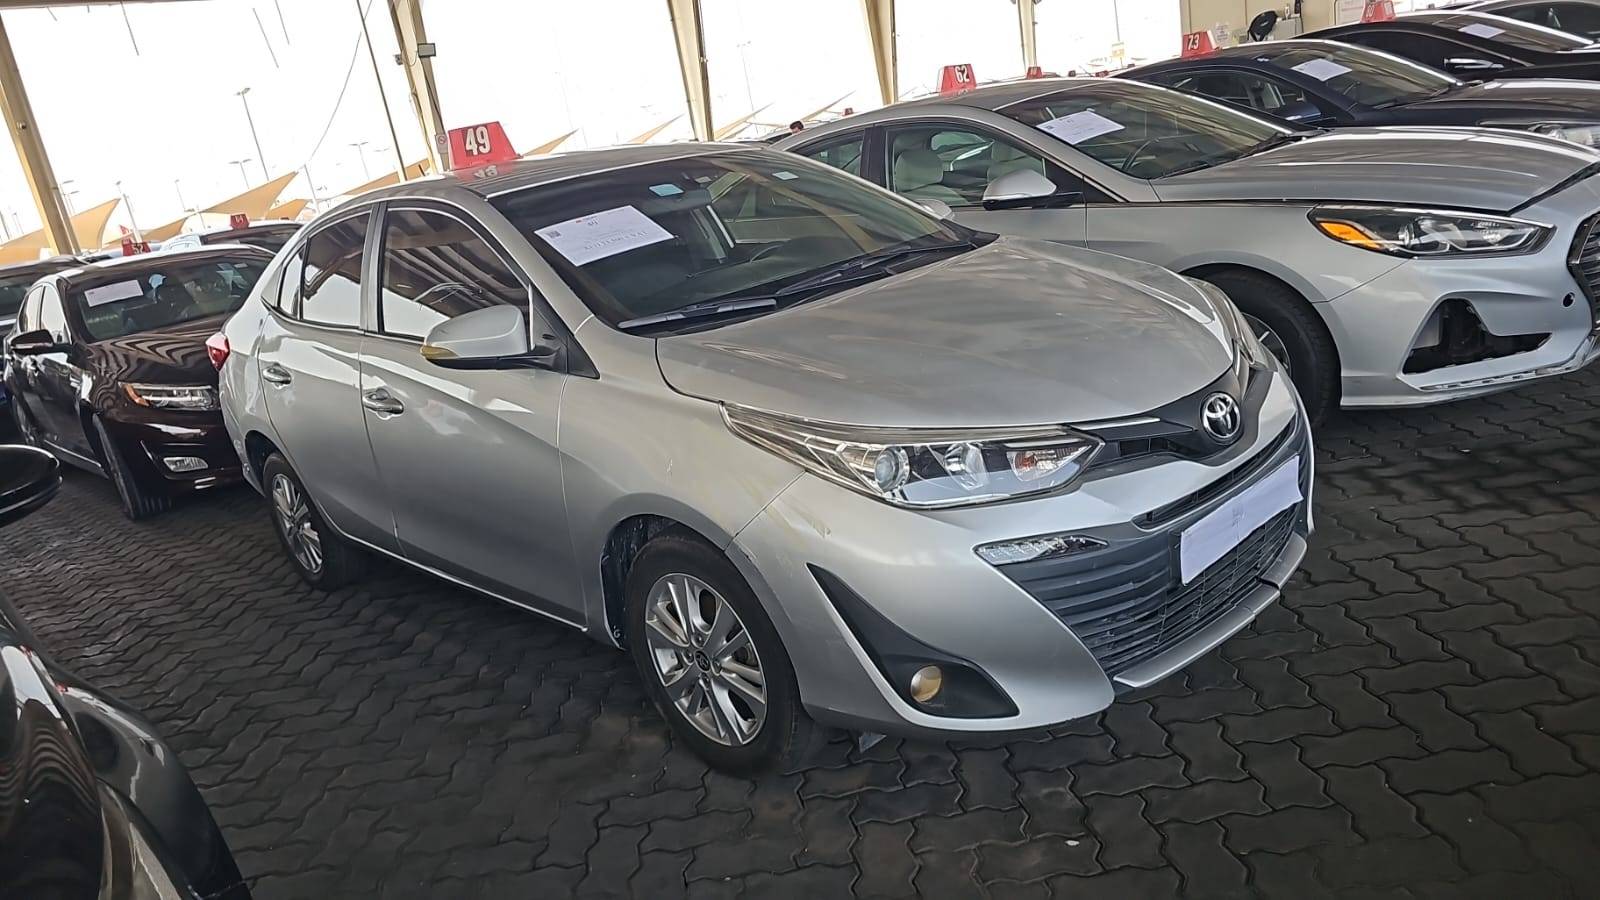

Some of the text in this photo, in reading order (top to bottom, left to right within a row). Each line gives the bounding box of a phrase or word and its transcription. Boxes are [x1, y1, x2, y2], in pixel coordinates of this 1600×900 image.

[1187, 34, 1200, 50] 73
[954, 65, 970, 84] 62
[465, 126, 491, 156] 49
